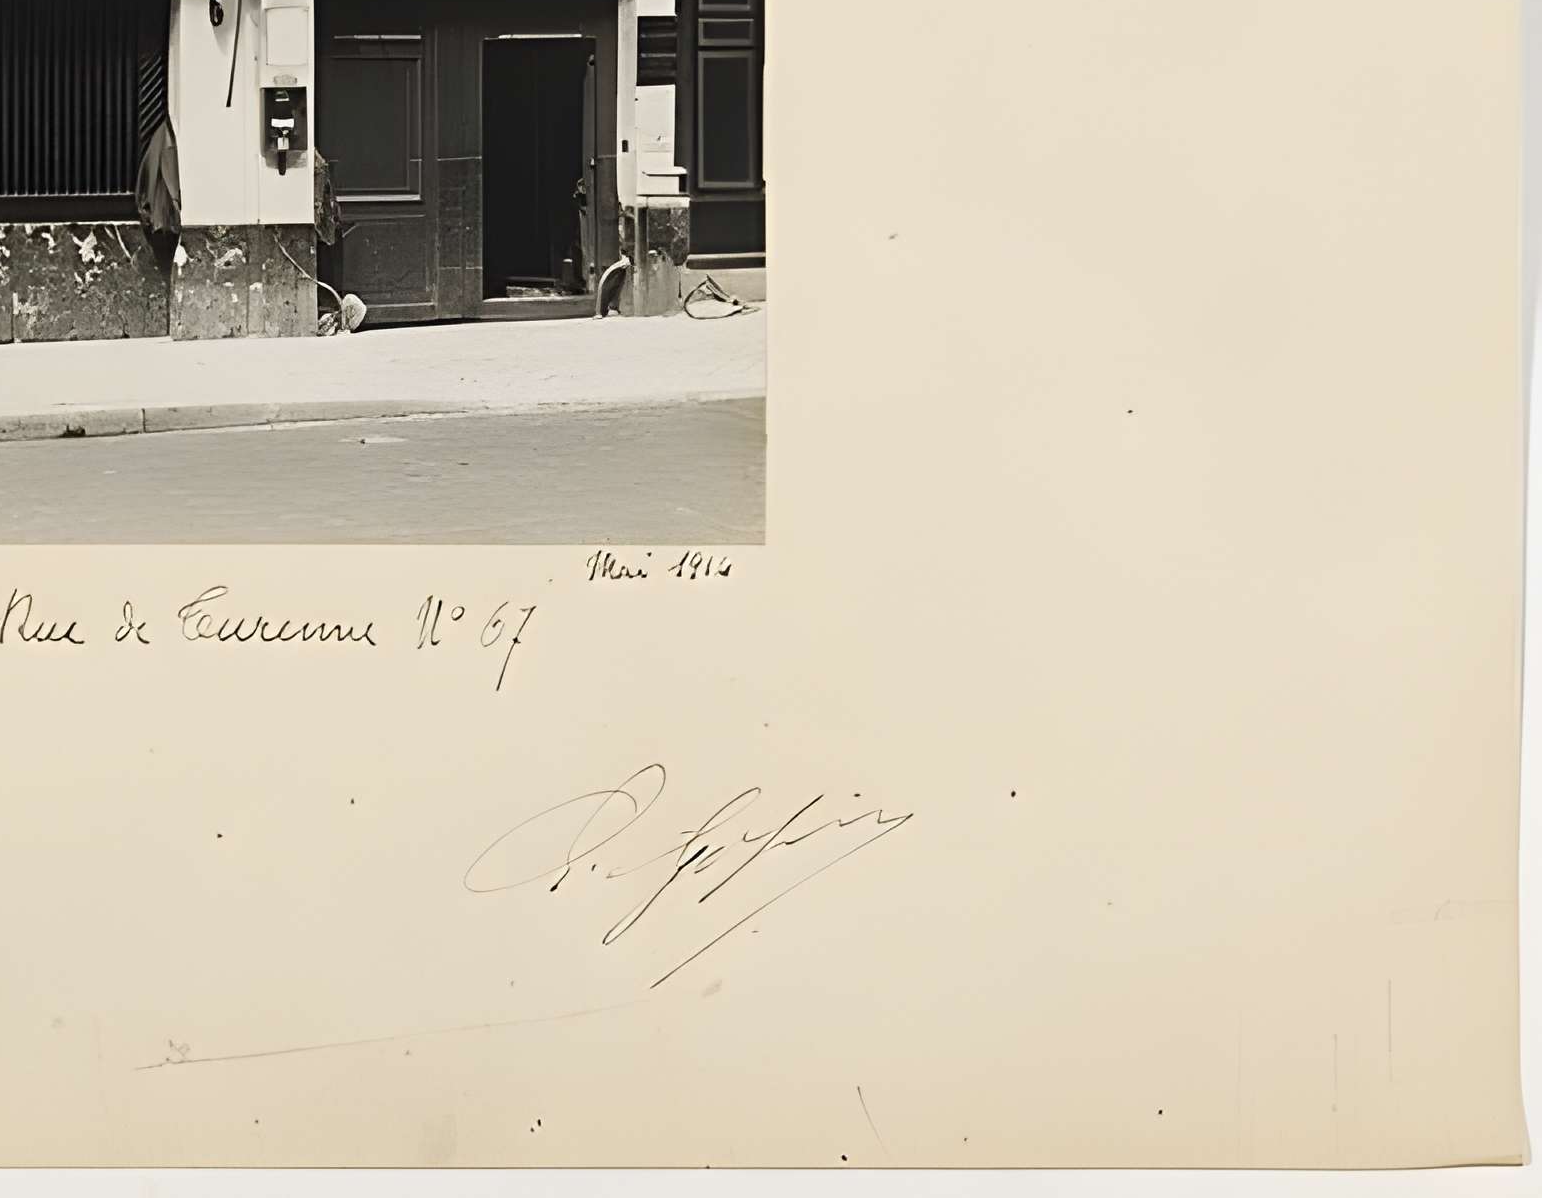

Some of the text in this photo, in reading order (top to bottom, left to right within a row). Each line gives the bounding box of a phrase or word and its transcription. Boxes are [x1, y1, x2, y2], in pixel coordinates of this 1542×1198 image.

[586, 549, 653, 582] Mai
[114, 599, 150, 645] de
[177, 585, 377, 647] Turenne
[480, 600, 537, 692] 67
